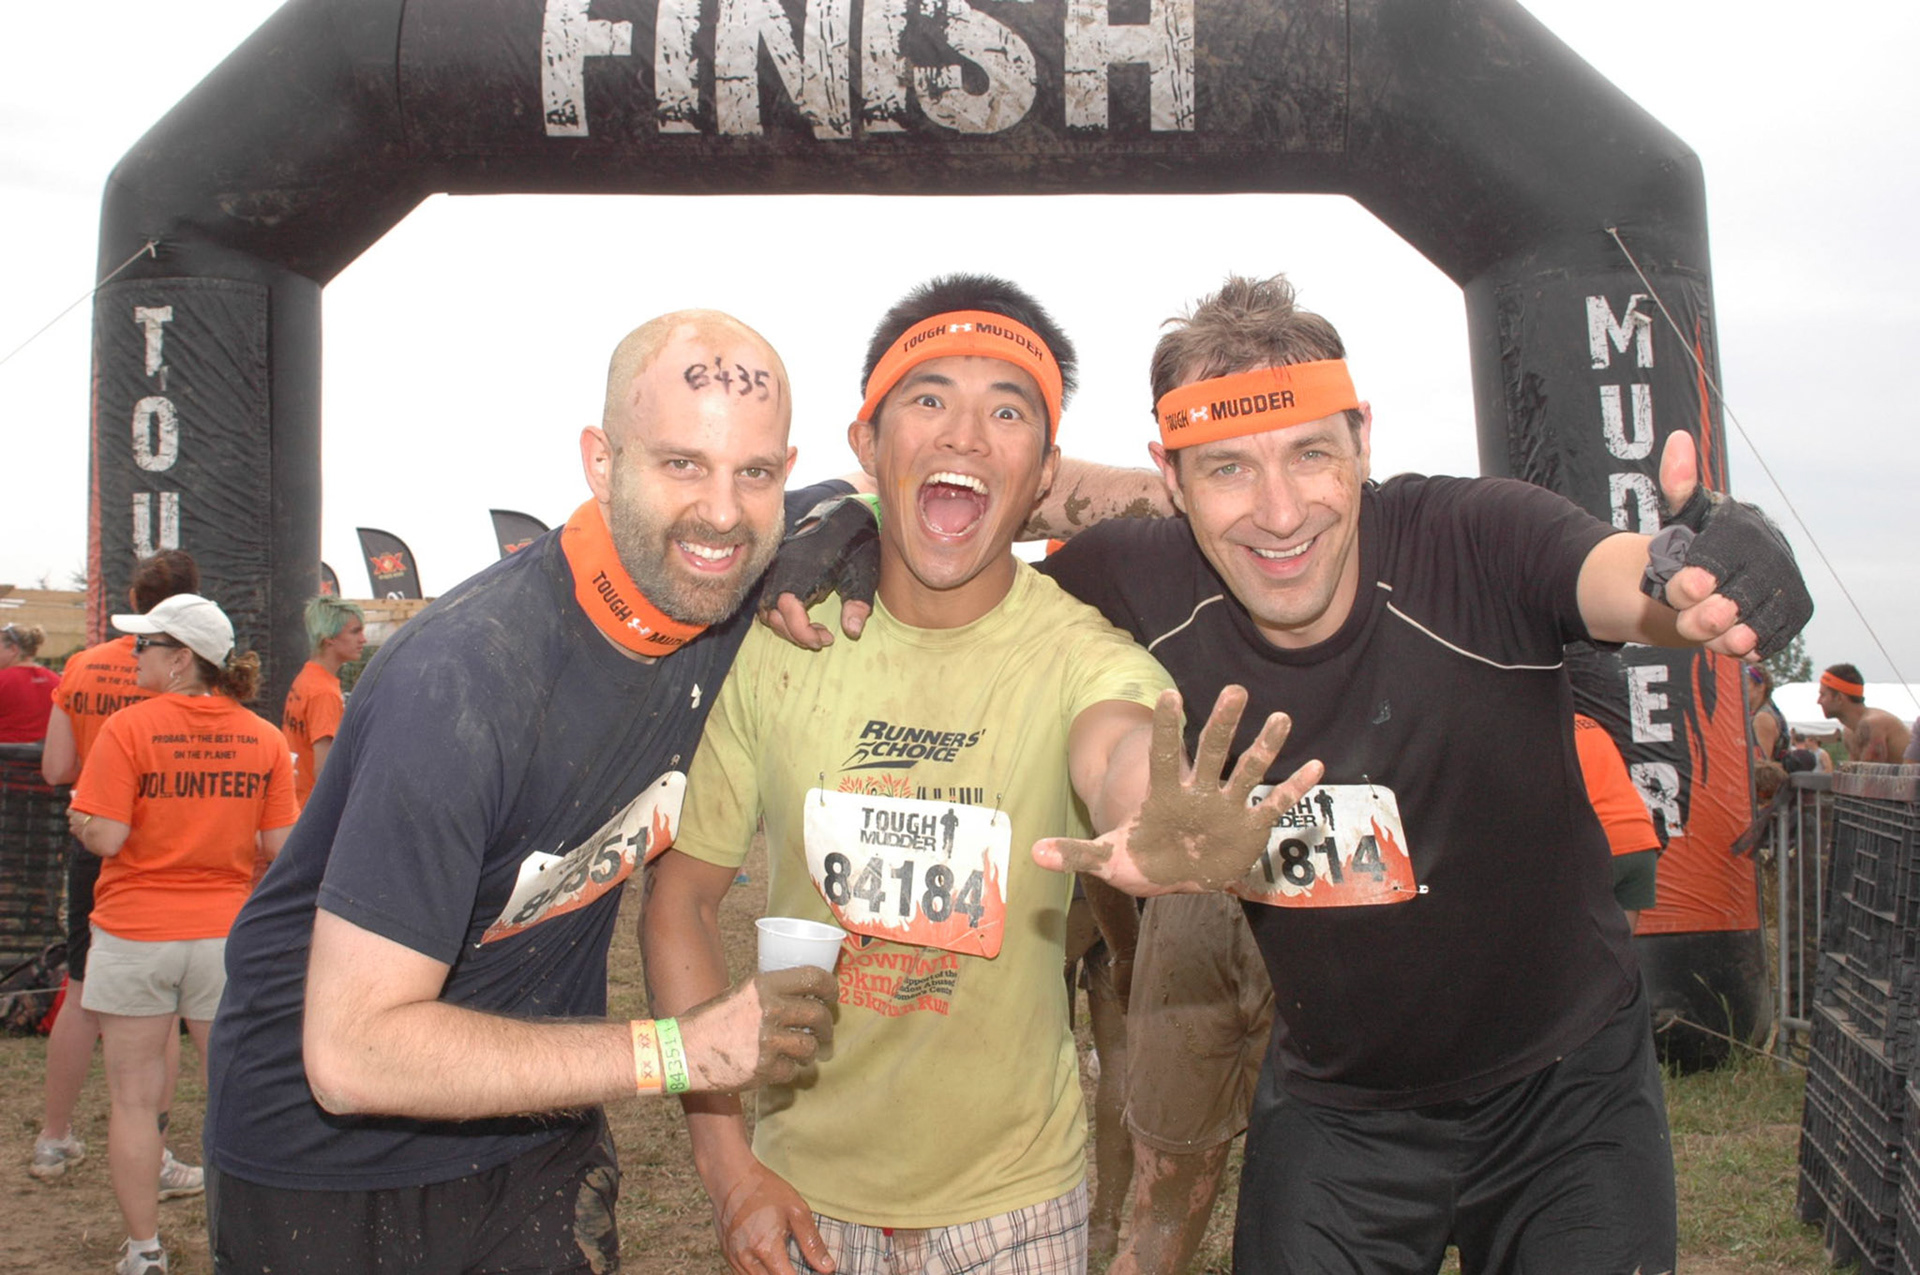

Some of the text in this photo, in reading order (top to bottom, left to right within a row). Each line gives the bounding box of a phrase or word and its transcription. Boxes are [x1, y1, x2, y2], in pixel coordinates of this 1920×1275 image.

[541, 0, 1196, 139] FINISH
[903, 322, 1043, 361] TOUGH MUDDER
[1165, 390, 1295, 433] TOUGH MUDDER
[1585, 294, 1684, 837] MUDER
[592, 570, 633, 621] TOUGH
[152, 734, 259, 745] PROBABLY THE BEST TEAM
[860, 720, 987, 748] RUNNERS'
[174, 750, 236, 760] ON THE PLANET
[870, 742, 959, 762] CHOICE
[861, 807, 937, 837] TOUGH
[860, 829, 936, 852] MUDDER
[823, 852, 985, 929] 84184
